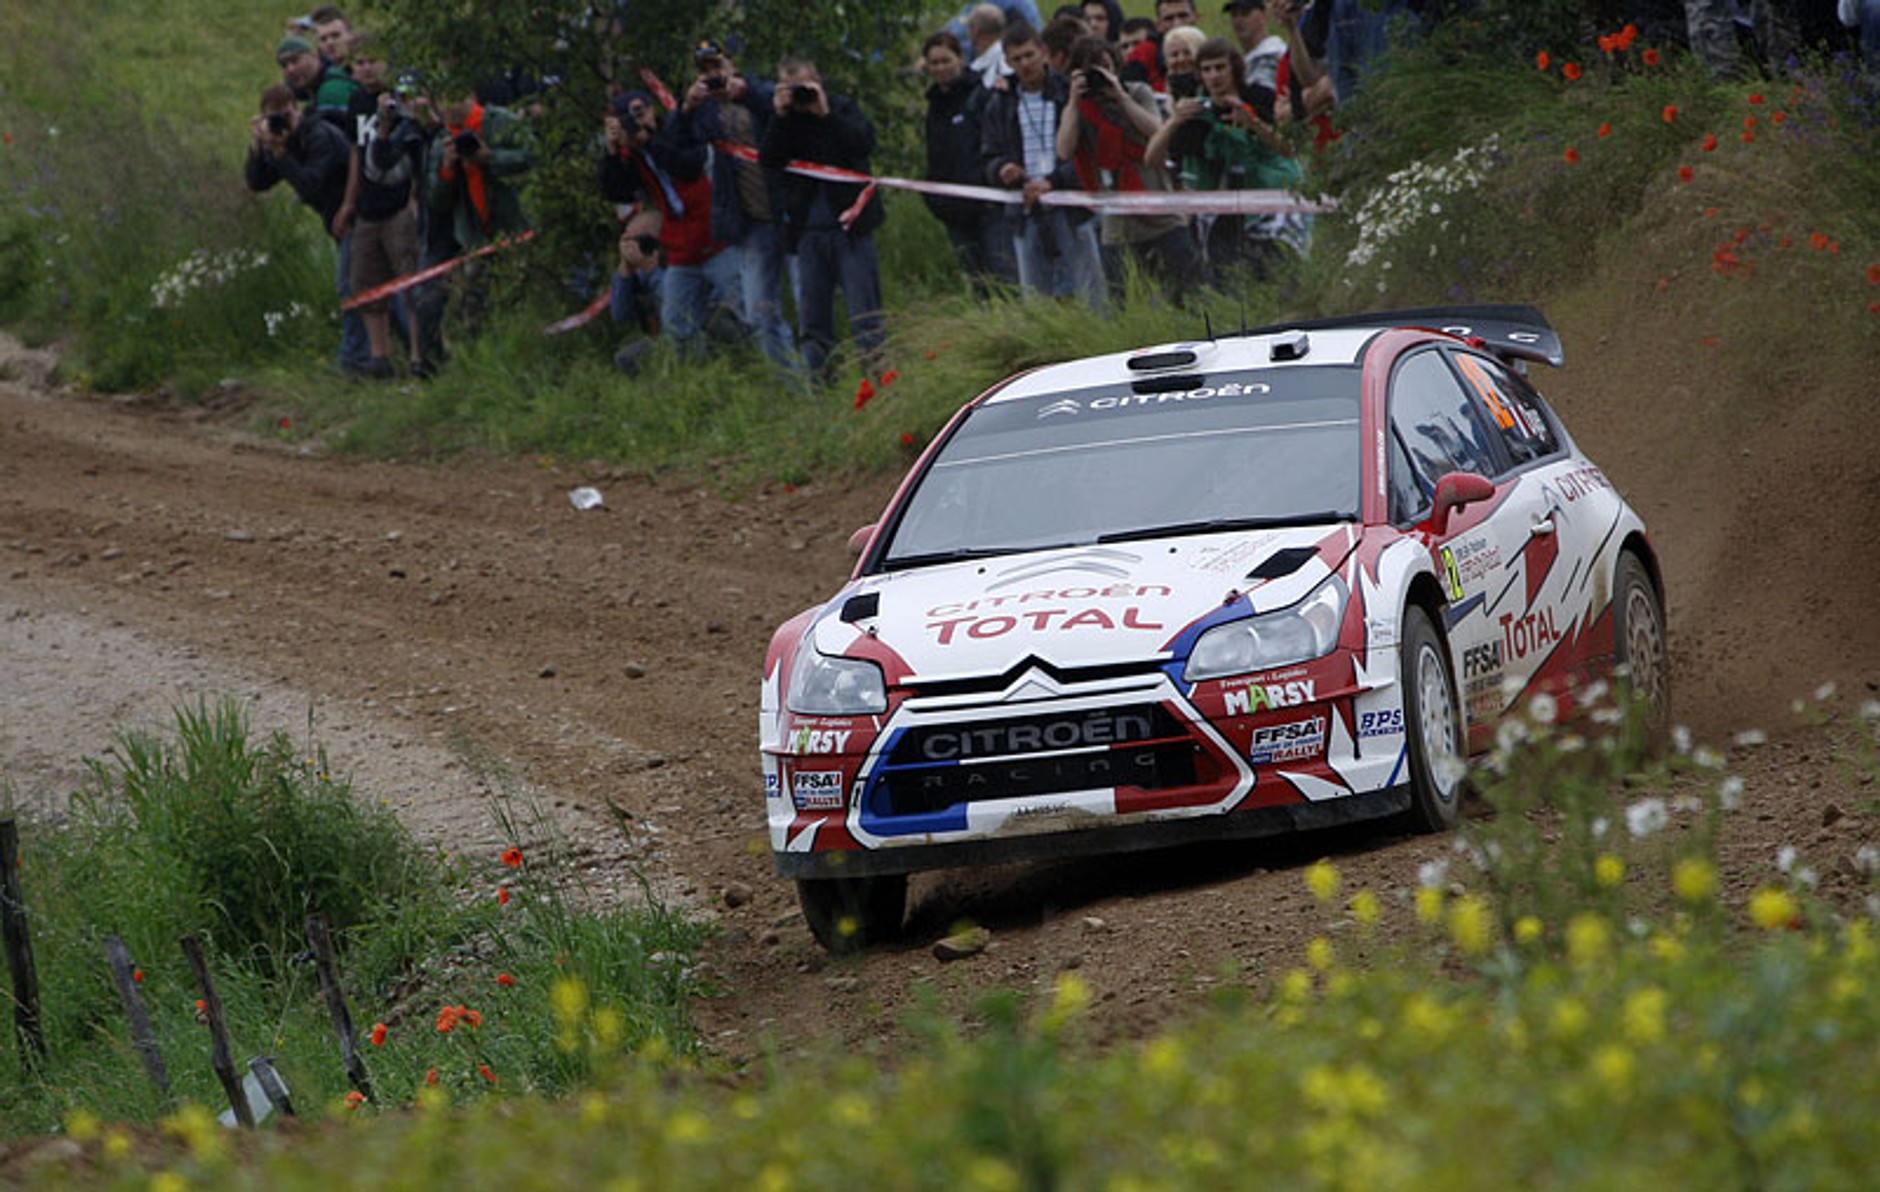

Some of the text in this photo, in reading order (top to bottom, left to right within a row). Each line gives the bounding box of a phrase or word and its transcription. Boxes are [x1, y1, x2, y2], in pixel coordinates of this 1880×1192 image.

[926, 607, 1164, 645] TOTAL
[1499, 606, 1561, 663] TOTAL
[1223, 679, 1316, 716] MARSY
[1361, 708, 1402, 730] BPS
[784, 724, 852, 756] MARSY
